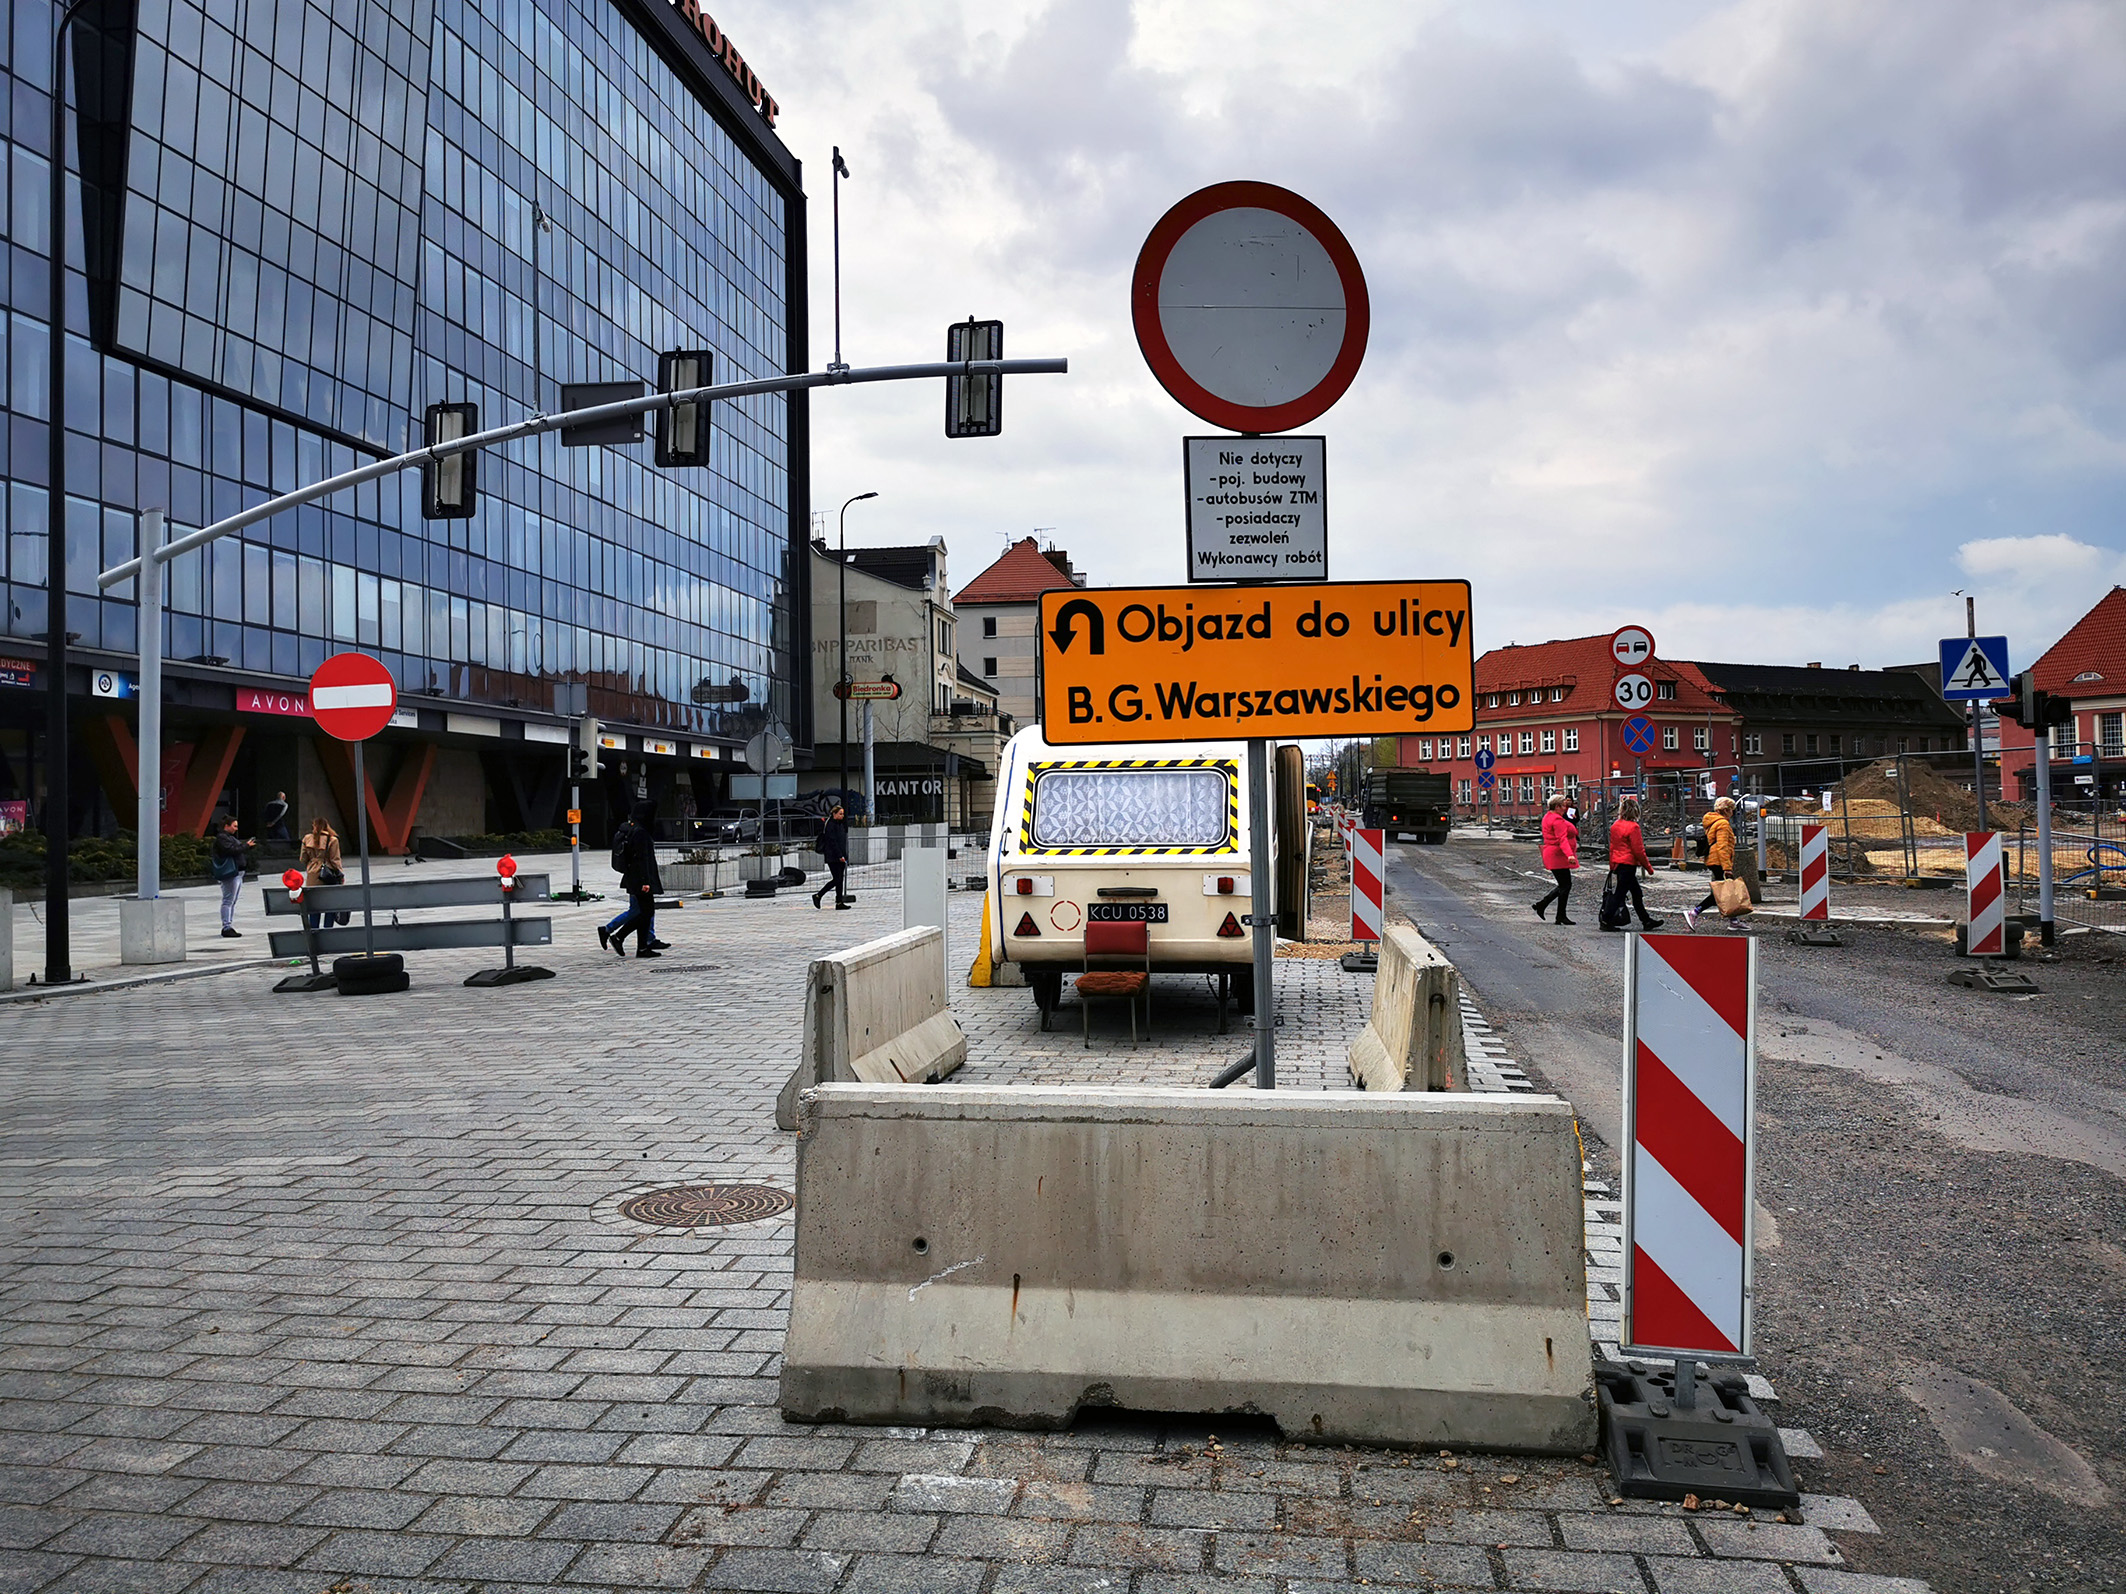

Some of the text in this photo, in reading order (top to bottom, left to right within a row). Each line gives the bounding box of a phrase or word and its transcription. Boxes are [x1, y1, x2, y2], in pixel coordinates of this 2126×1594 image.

[1219, 451, 1303, 469] Nie dotyczy
[1253, 471, 1306, 489] budowy
[1197, 490, 1318, 505] -autobusów ZTM
[1216, 511, 1301, 528] -posiadaczy
[1229, 530, 1290, 545] zezwoleń
[1197, 550, 1322, 568] Wykonawcy robót
[1117, 598, 1466, 653] Objazd do ulicy
[845, 638, 918, 652] PARIBAS
[0, 658, 31, 671] DYCZNE
[1619, 681, 1652, 703] 30
[251, 693, 305, 713] AVON
[876, 780, 942, 795] KANTOR
[1090, 906, 1166, 920] KCU 0538
